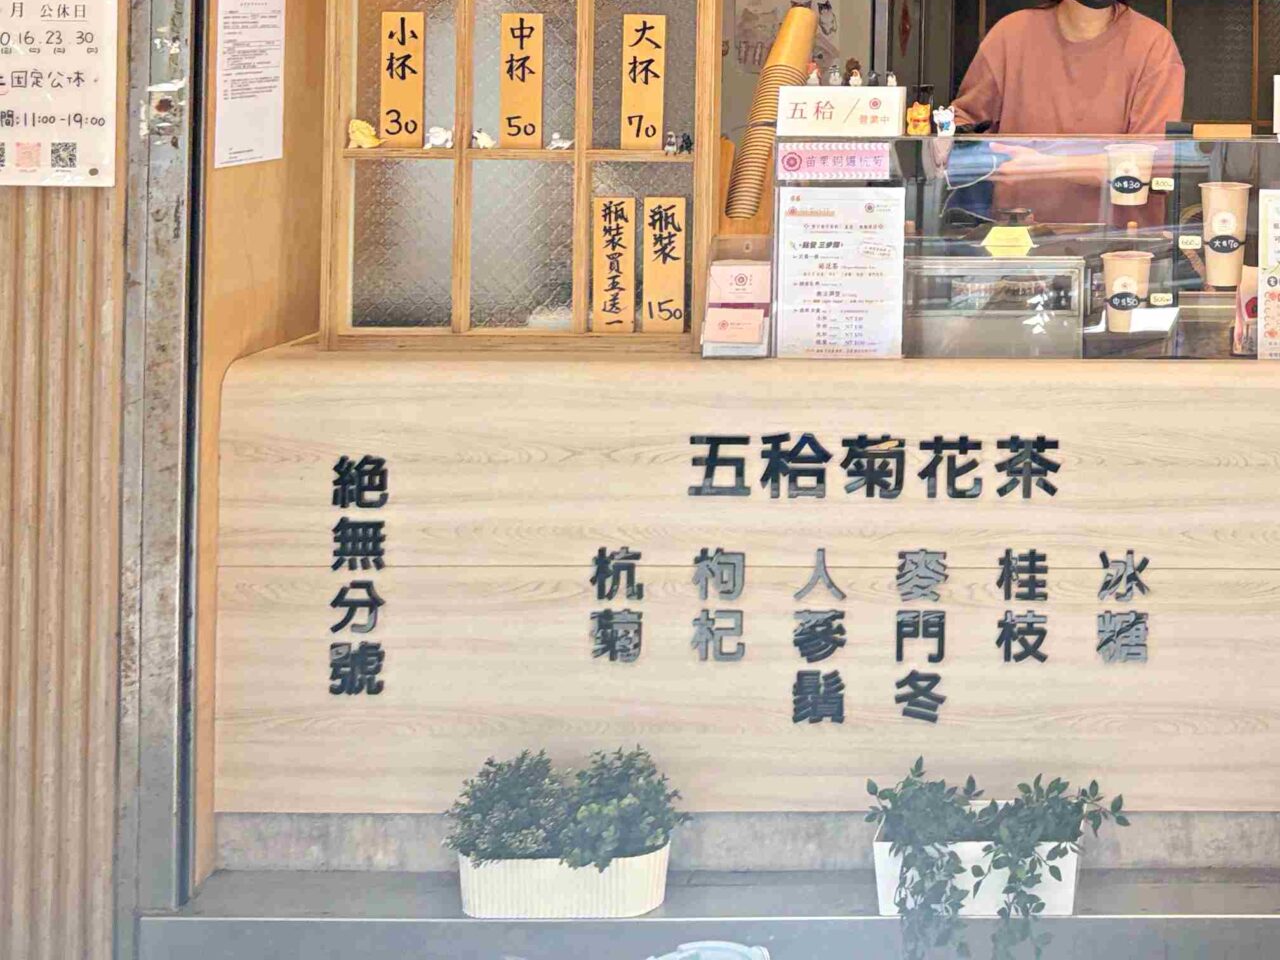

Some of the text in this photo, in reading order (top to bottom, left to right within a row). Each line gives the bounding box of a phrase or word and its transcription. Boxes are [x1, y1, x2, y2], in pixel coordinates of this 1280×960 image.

[40, 3, 86, 18] 公休日
[386, 16, 418, 81] 小杯
[505, 17, 536, 83] 中杯
[628, 20, 661, 86] 大杯
[385, 109, 418, 136] 30
[506, 115, 536, 137] 50
[627, 114, 656, 139] 70
[647, 204, 682, 265] 瓶裝
[647, 299, 683, 322] 150
[329, 454, 389, 696] 絕無分號
[589, 546, 644, 663] 杭菊
[691, 547, 746, 662] 枸杞
[995, 548, 1049, 663] 桂枝
[1095, 549, 1151, 664] 冰糖
[894, 548, 948, 724] 麥門冬
